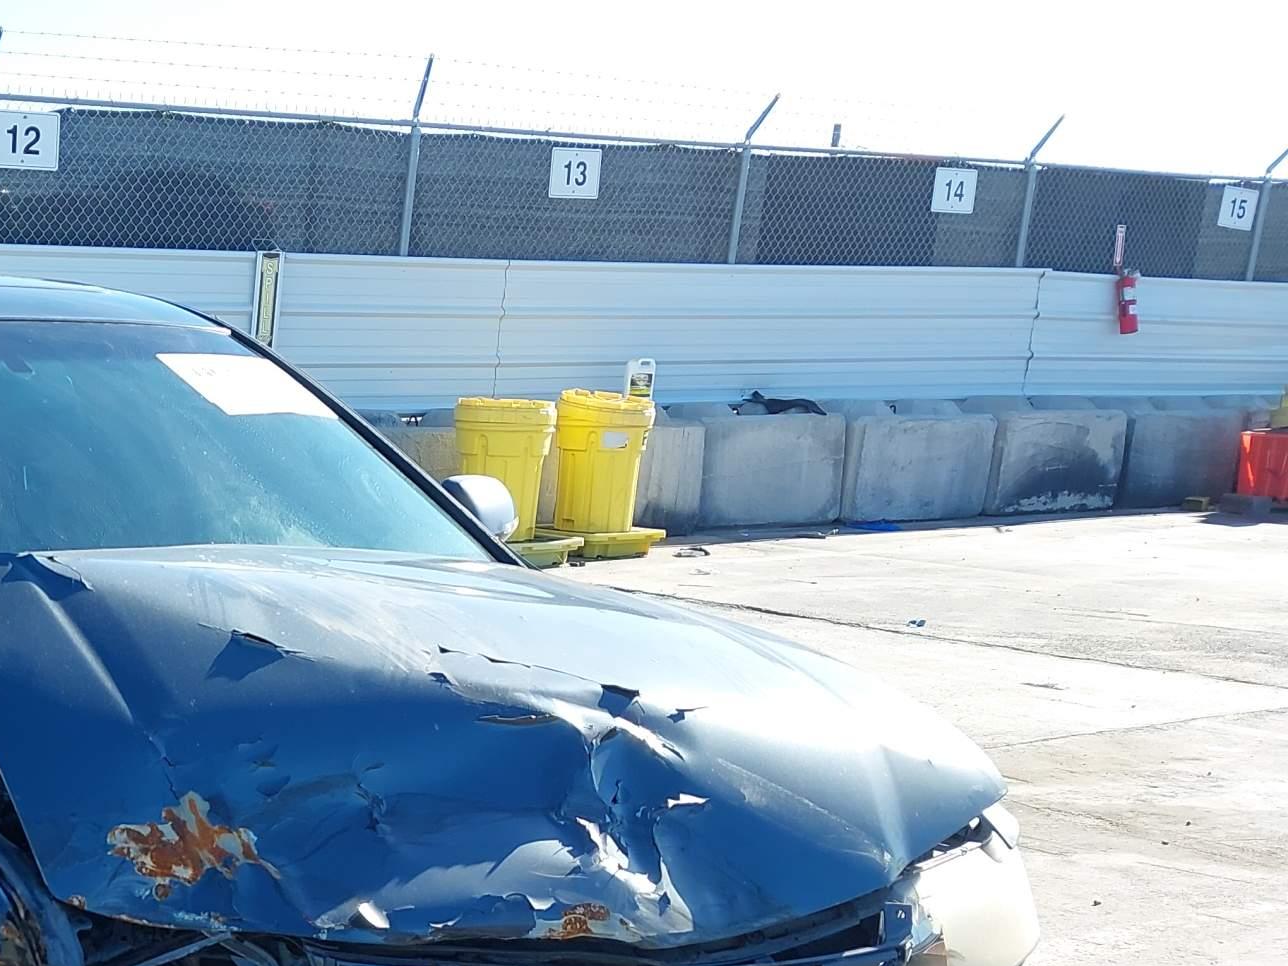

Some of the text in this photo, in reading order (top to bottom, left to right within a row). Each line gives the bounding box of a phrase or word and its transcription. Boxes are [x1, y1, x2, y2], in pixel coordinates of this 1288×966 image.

[6, 124, 41, 155] 12
[564, 160, 587, 186] 13
[945, 179, 964, 202] 14
[1230, 198, 1248, 219] 15
[262, 262, 274, 333] SPILL
